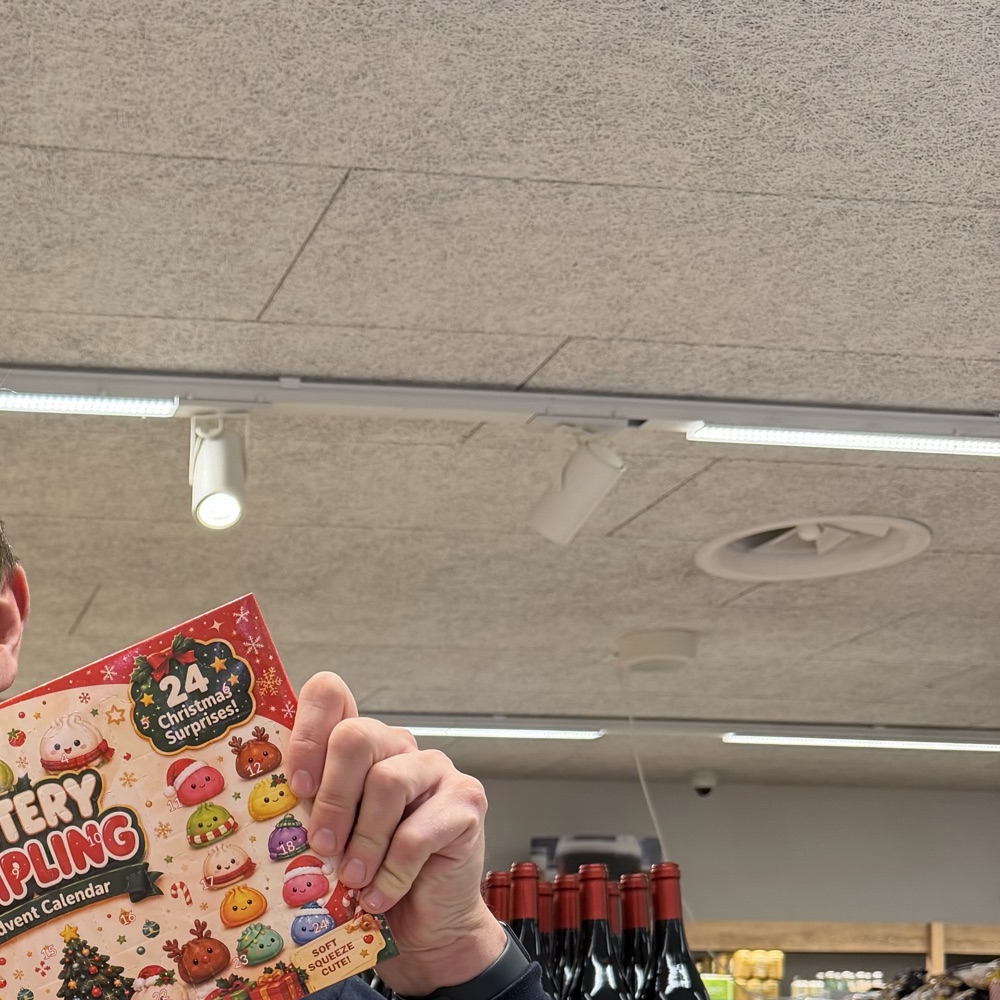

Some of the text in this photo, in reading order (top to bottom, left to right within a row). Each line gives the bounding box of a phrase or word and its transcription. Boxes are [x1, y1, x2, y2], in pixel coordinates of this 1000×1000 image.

[159, 663, 210, 708] 24
[158, 687, 233, 730] Christmas
[140, 718, 150, 730] 5
[164, 699, 240, 745] Surprises!
[60, 753, 70, 765] 4
[246, 762, 264, 777] 12
[166, 798, 183, 813] 11
[86, 831, 102, 848] 10
[279, 841, 297, 856] 18
[11, 867, 21, 880] 9
[200, 875, 215, 891] 17
[40, 880, 111, 915] Calendar
[118, 908, 137, 926] 16
[312, 920, 329, 935] 24
[40, 943, 58, 961] 15
[311, 938, 338, 957] SOFT
[232, 954, 249, 970] 23
[308, 942, 355, 972] SQUEEZE
[321, 958, 352, 976] CUTE!
